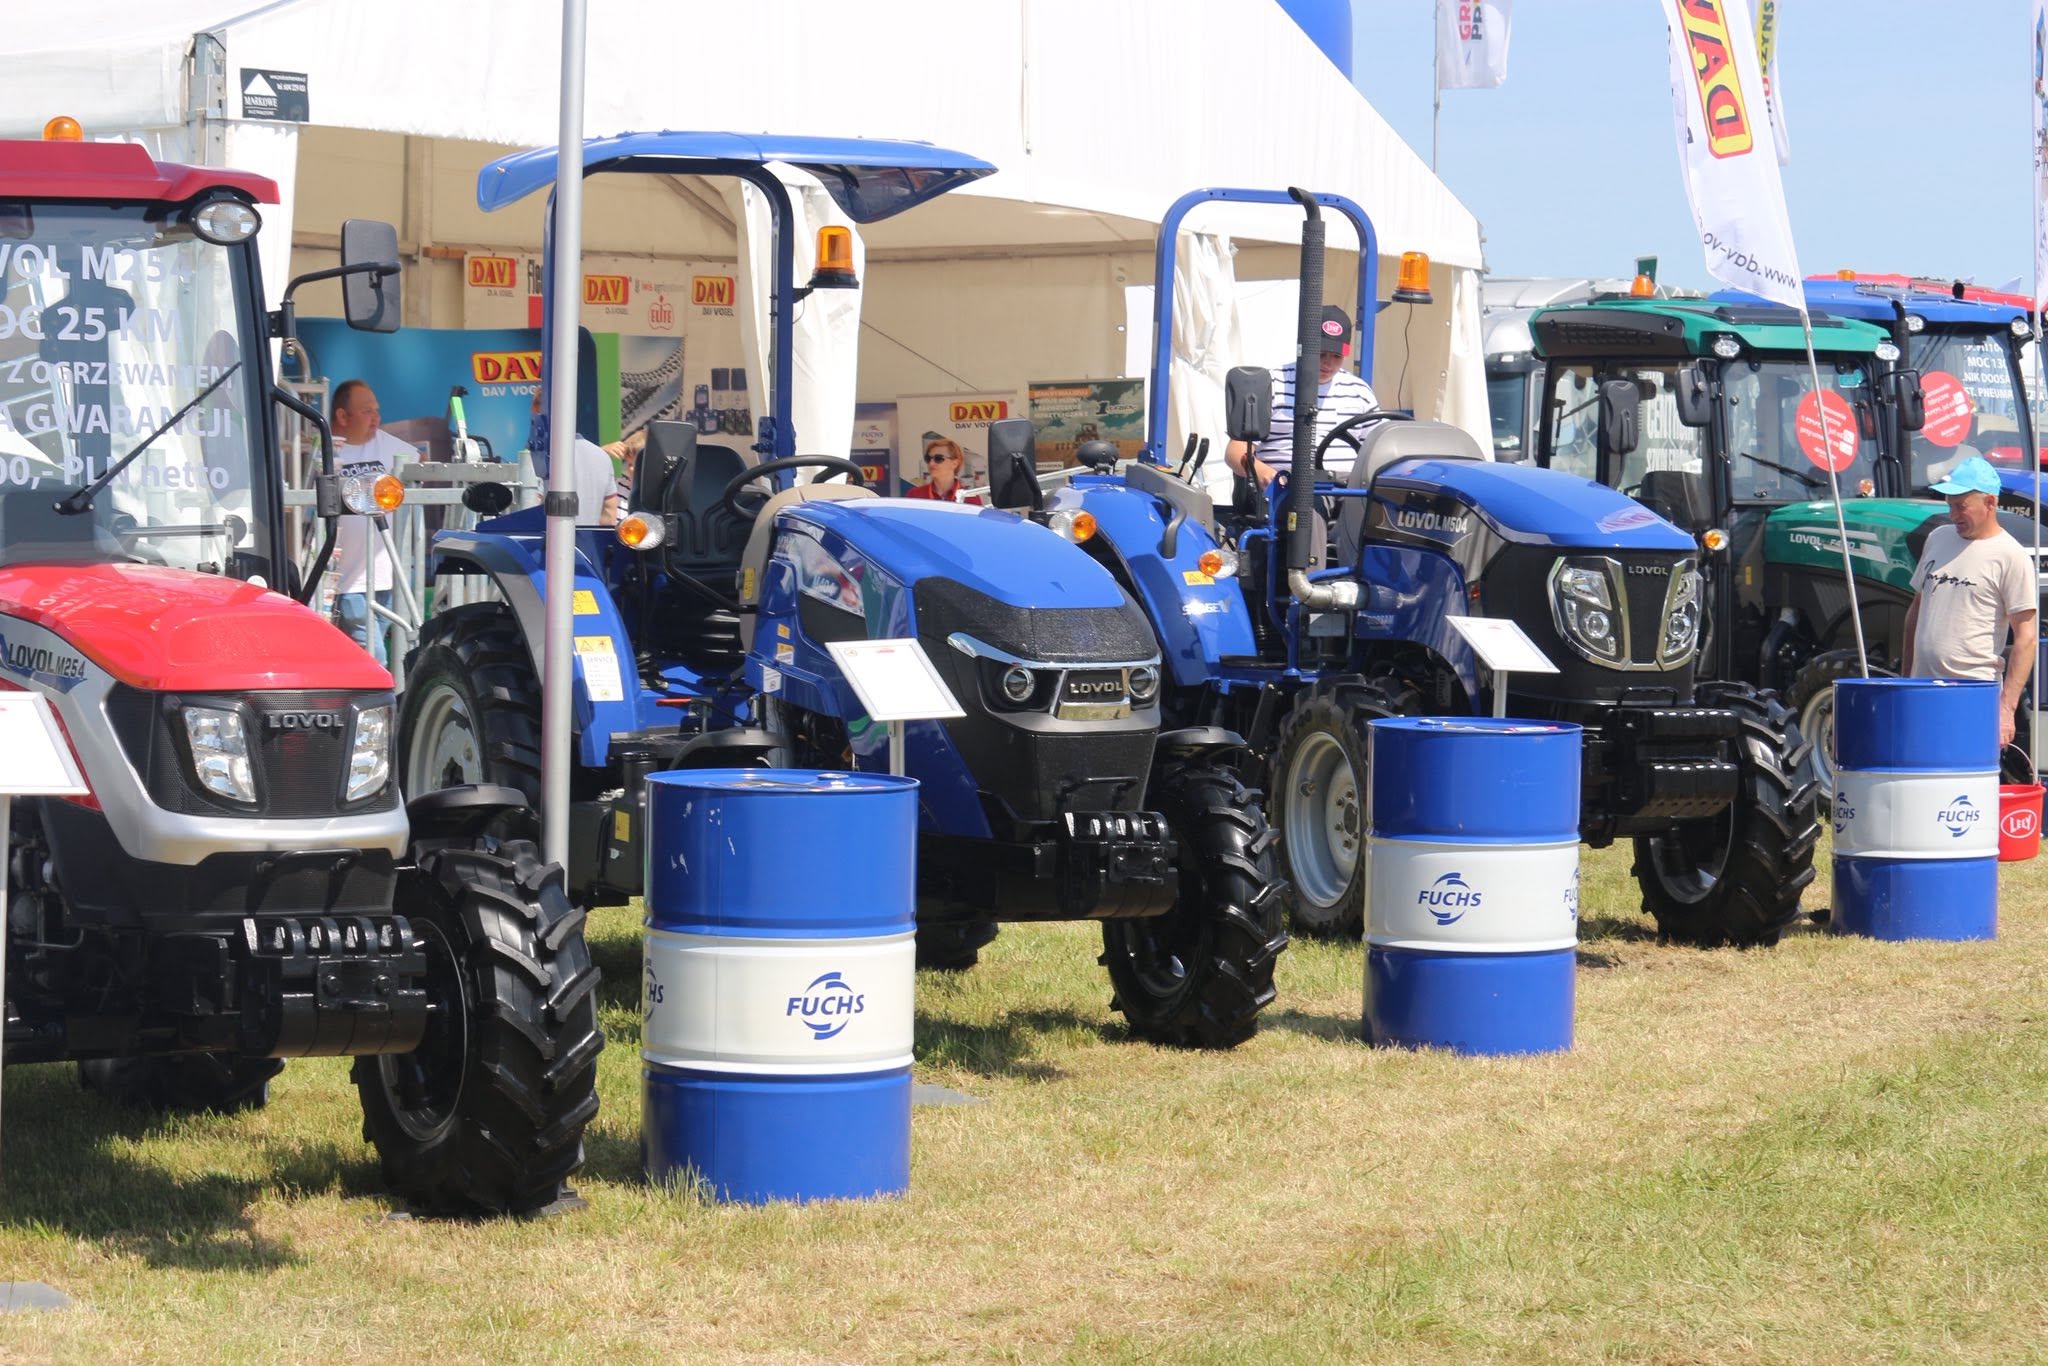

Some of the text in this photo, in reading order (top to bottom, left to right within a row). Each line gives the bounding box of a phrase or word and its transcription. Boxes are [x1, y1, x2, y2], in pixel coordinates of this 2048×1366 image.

[1459, 0, 1471, 41] GR
[81, 246, 194, 284] M254
[473, 259, 509, 284] DAV
[586, 278, 622, 302] DAV
[694, 280, 726, 303] DAV
[57, 307, 106, 342] 25
[119, 308, 181, 342] KM
[7, 361, 24, 384] Z
[1967, 356, 1991, 368] MOC
[1980, 373, 2011, 384] DOOSA
[482, 386, 507, 397] DAV
[25, 404, 231, 438] GWARANCJI
[954, 404, 995, 420] DAV
[141, 460, 230, 489] netto
[340, 462, 385, 478] adidas
[1397, 510, 1468, 534] LOVOL M504
[1790, 533, 1823, 546] LOVOL
[1629, 566, 1669, 576] LOVOL
[8, 643, 86, 679] LOVOL M254
[1069, 681, 1123, 694] LOVOL
[268, 713, 345, 729] LOVOL
[1936, 810, 1980, 822] FUCHS
[1418, 890, 1482, 907] FUCHS
[786, 994, 865, 1017] FUCHS
